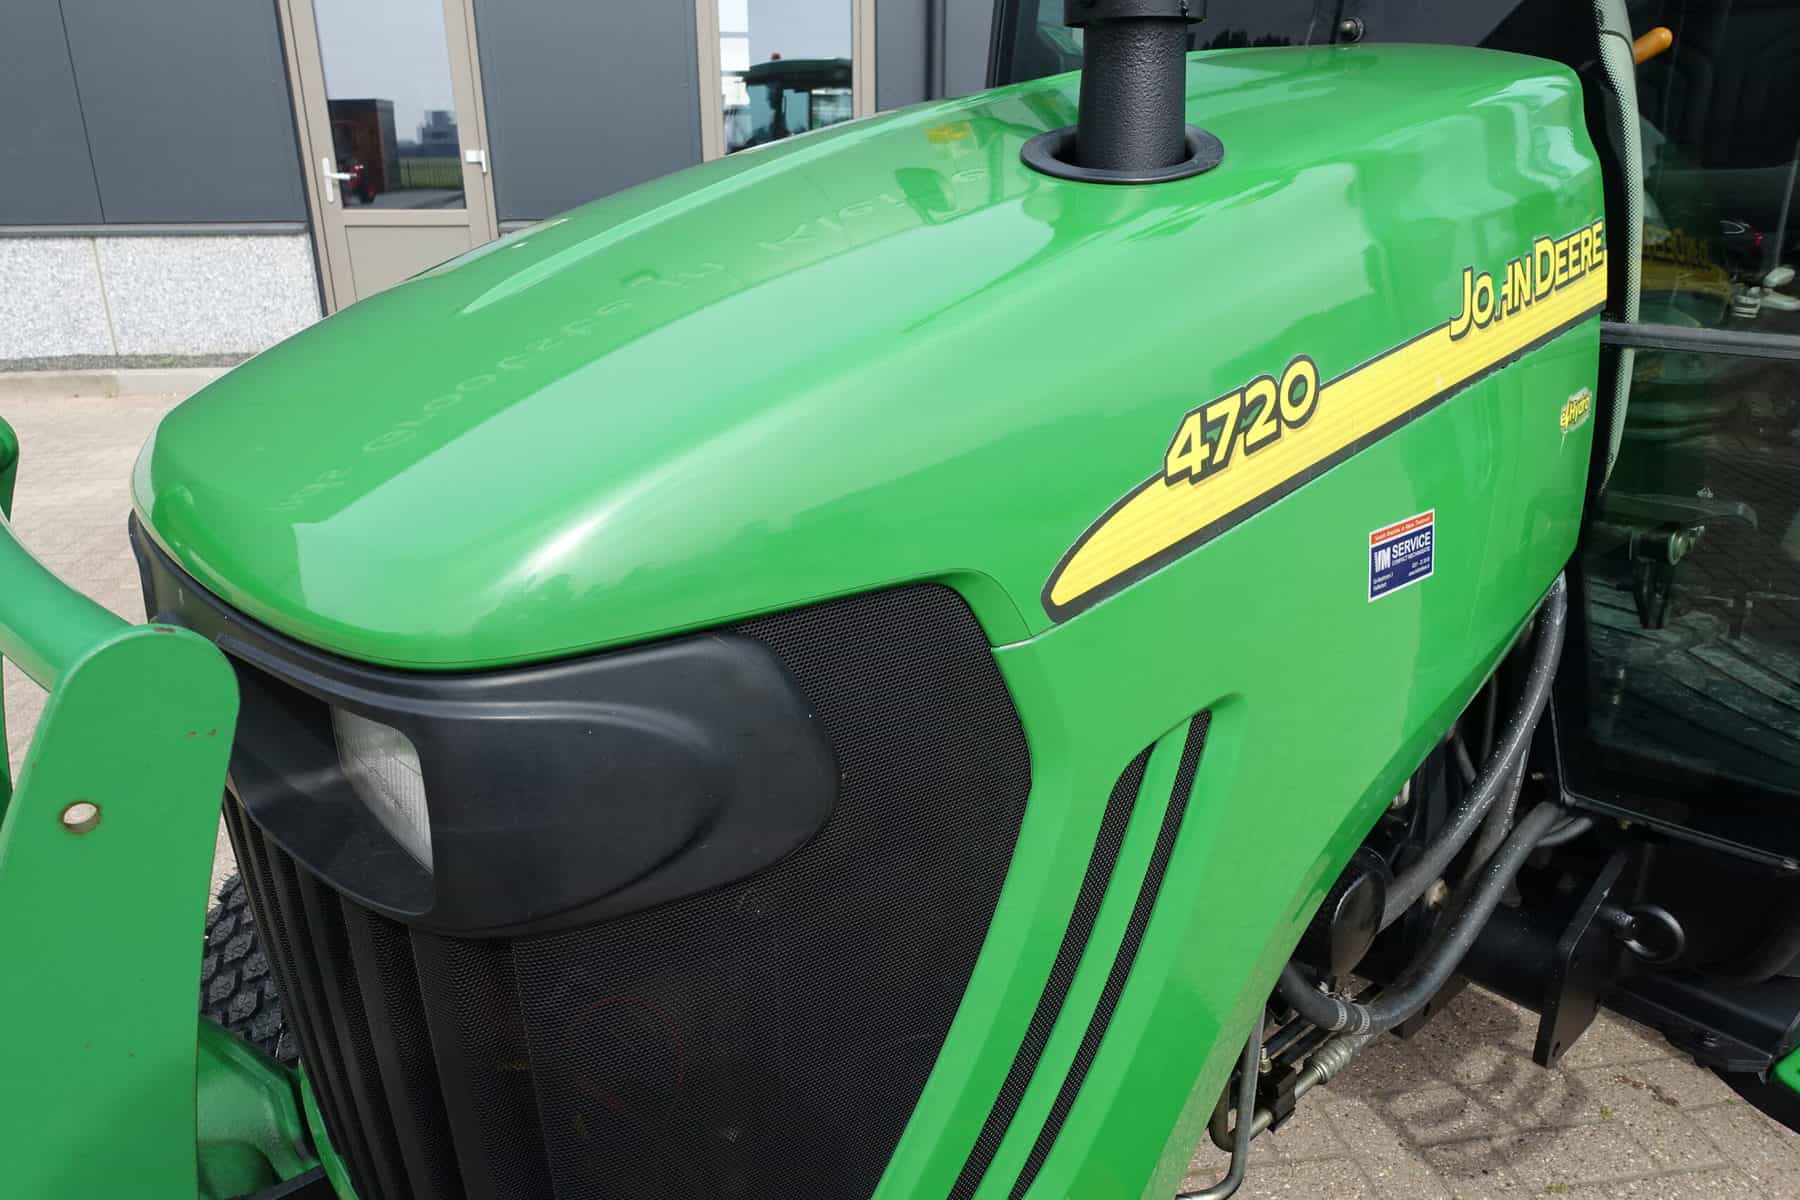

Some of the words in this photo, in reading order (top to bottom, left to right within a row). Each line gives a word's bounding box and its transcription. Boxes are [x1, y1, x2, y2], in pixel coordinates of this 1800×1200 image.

[1534, 219, 1604, 301] DEERE
[1164, 354, 1320, 487] 4720
[1392, 531, 1431, 559] SERVICE
